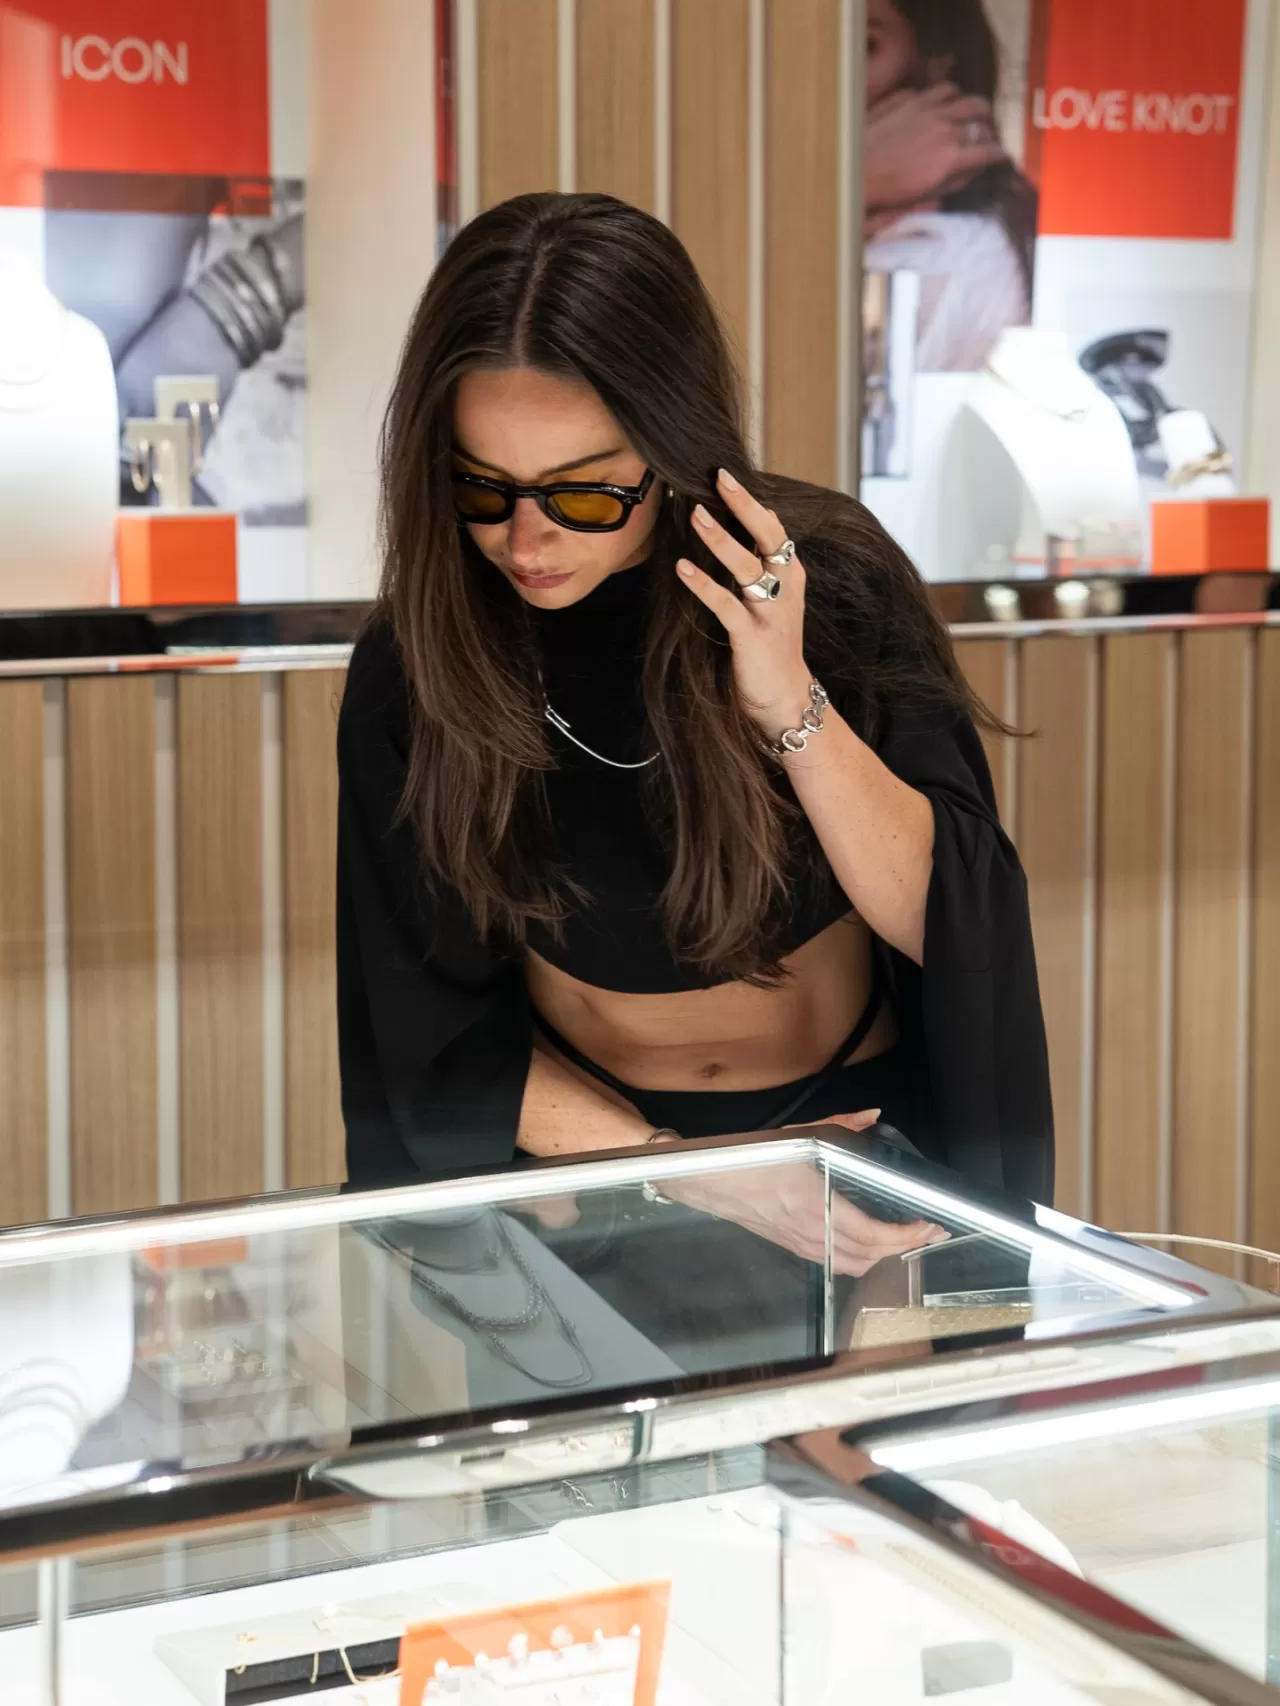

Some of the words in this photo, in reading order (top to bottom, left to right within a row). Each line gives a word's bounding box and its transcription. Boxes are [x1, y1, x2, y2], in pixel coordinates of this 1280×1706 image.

[61, 34, 188, 84] ICON
[1034, 88, 1128, 131] LOVE
[1132, 93, 1233, 134] KNOT
